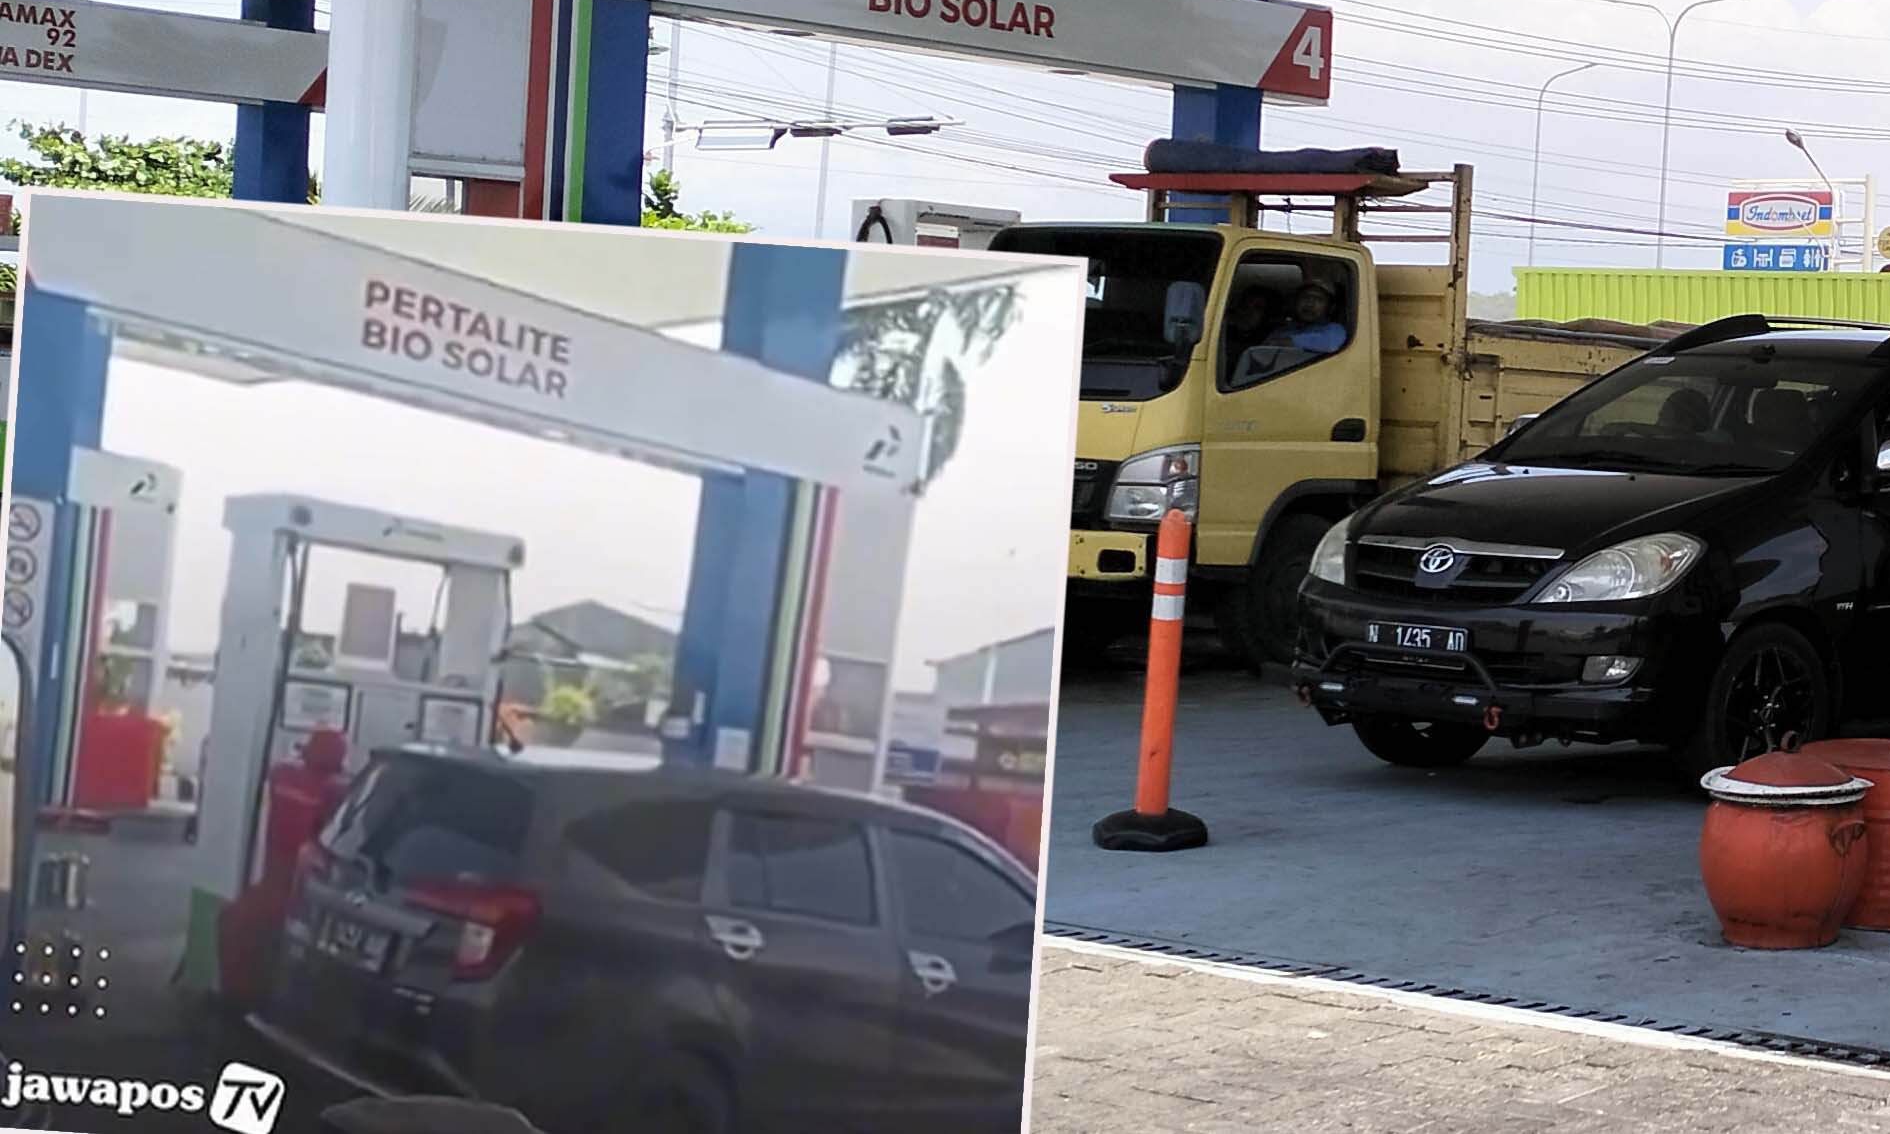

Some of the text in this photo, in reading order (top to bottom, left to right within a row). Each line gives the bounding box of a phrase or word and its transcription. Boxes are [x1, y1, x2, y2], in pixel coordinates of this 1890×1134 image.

[25, 49, 74, 73] DEX
[47, 27, 76, 48] 92
[1293, 26, 1325, 80] 4
[364, 279, 572, 366] PERTALITE
[362, 317, 568, 400] BIO SOLAR
